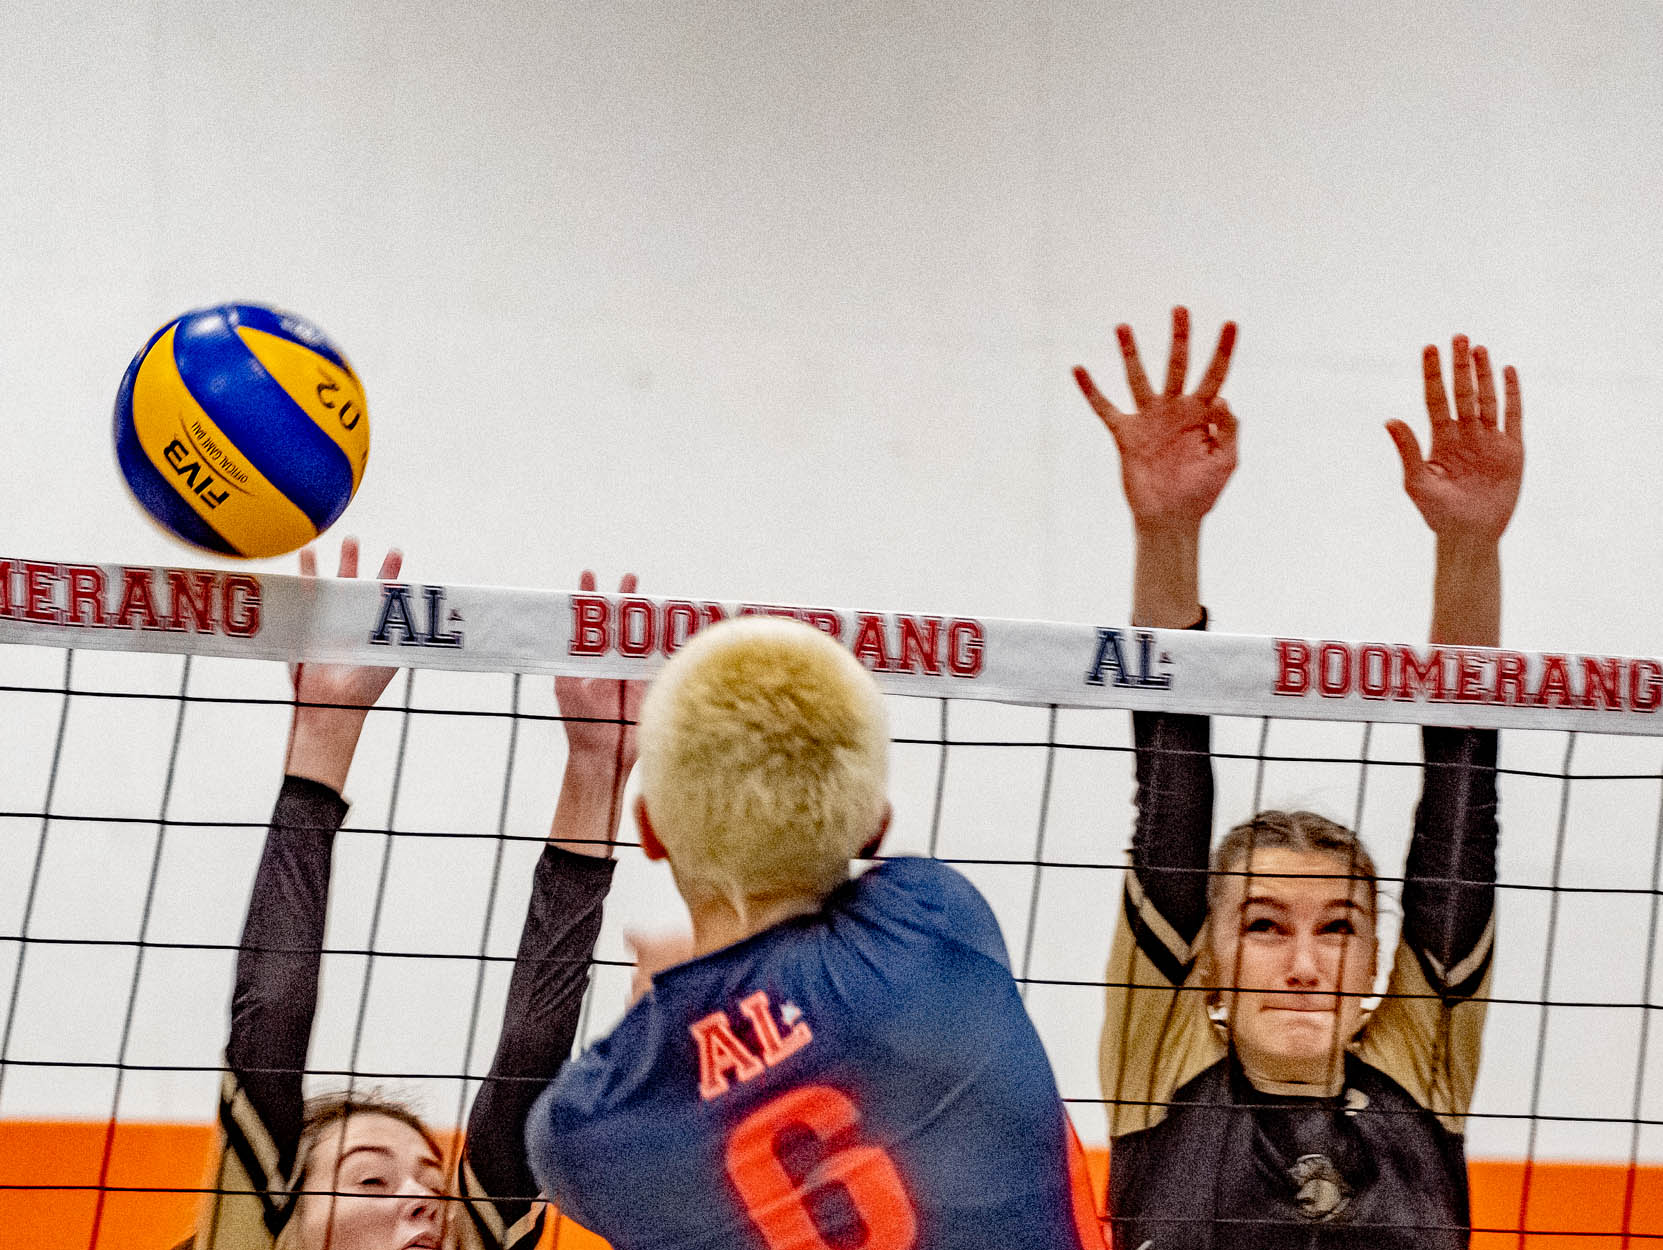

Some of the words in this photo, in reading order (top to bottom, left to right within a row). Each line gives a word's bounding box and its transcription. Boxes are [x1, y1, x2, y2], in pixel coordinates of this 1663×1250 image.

[163, 439, 230, 509] FIVB
[201, 437, 223, 461] GAME
[219, 455, 248, 483] OFFICIAL
[0, 557, 261, 638] ERANG
[1273, 636, 1663, 713] BOOMERANG
[689, 989, 813, 1100] AL
